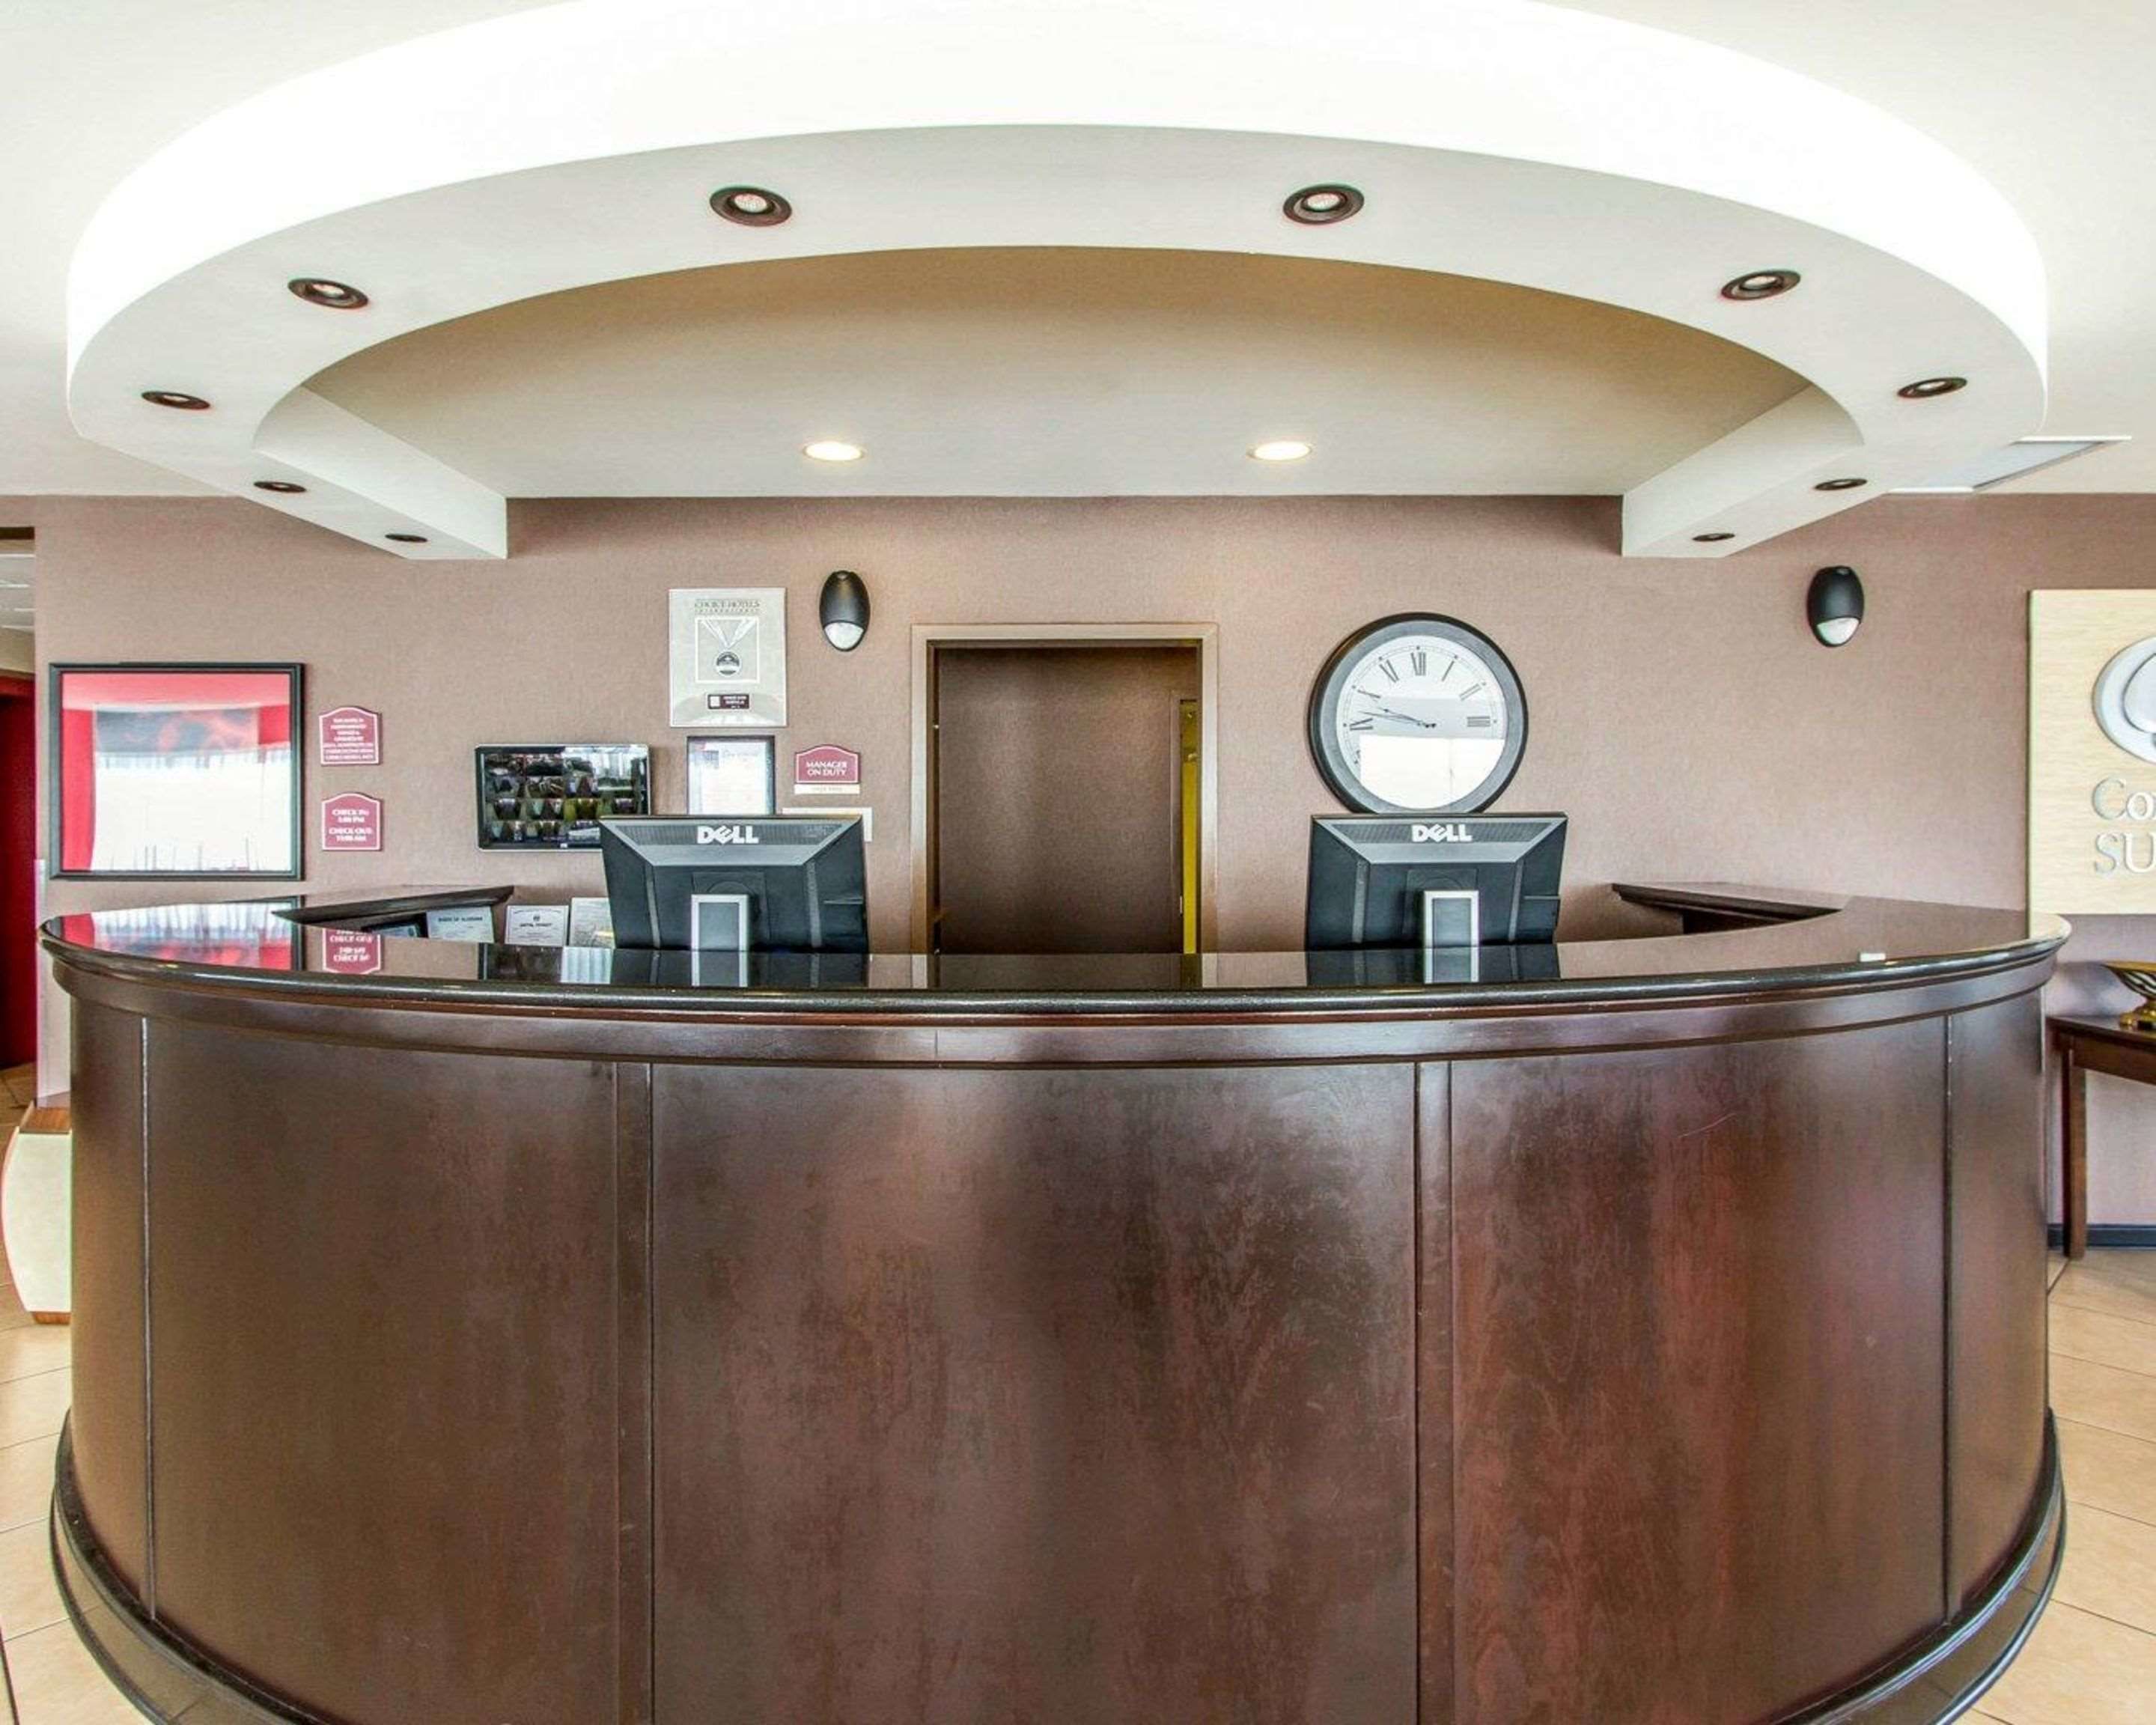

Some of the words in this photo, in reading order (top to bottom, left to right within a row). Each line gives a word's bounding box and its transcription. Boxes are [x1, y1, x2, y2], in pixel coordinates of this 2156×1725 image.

[806, 760, 847, 768] MANAGER
[807, 768, 821, 776] ON
[823, 768, 847, 776] DUTY
[697, 825, 759, 845] DELL
[1411, 824, 1473, 842] DELL
